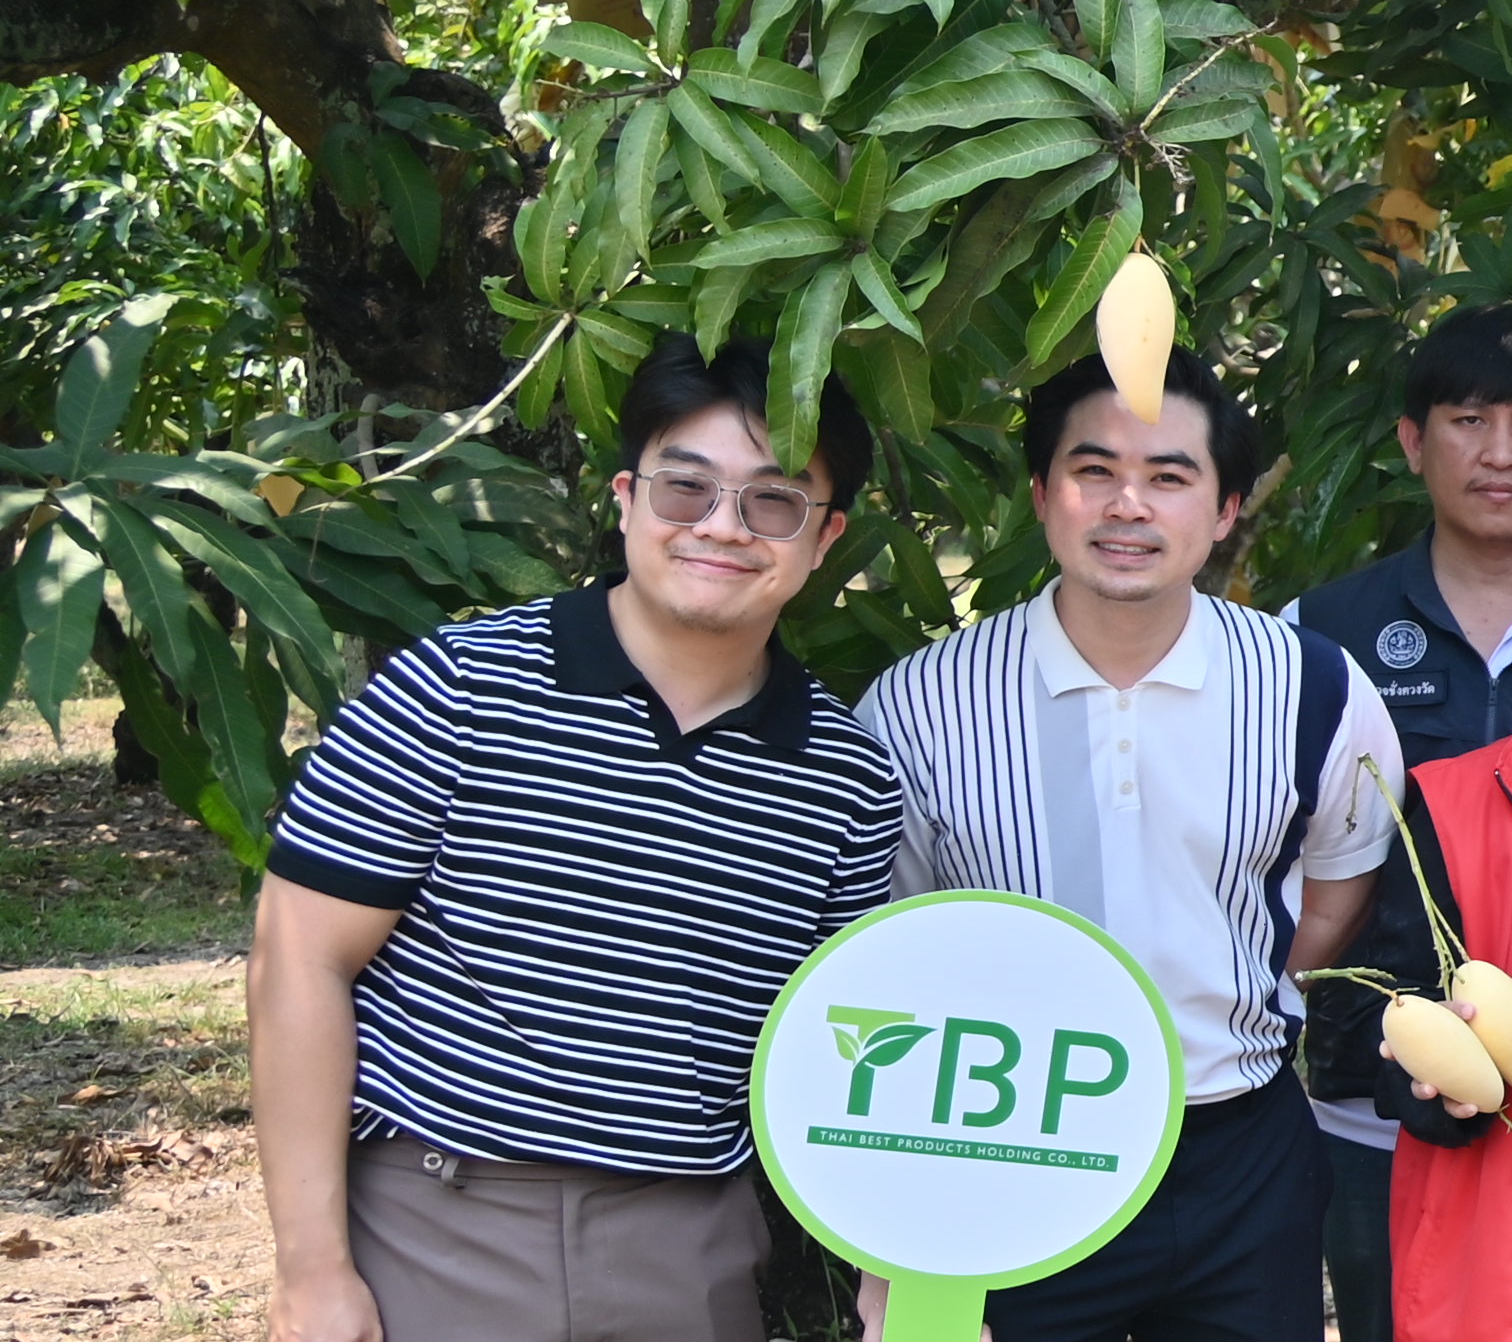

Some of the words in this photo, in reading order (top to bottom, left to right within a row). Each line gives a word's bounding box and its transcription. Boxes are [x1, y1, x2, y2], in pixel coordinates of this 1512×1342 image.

[826, 1005, 1130, 1135] TBP
[820, 1130, 853, 1143] THAI
[859, 1134, 892, 1147] BEST
[897, 1138, 971, 1155] PRODUCTS
[977, 1145, 1041, 1162] HOLDING
[1048, 1152, 1076, 1166] CO.,
[1081, 1155, 1110, 1168] LTD.
